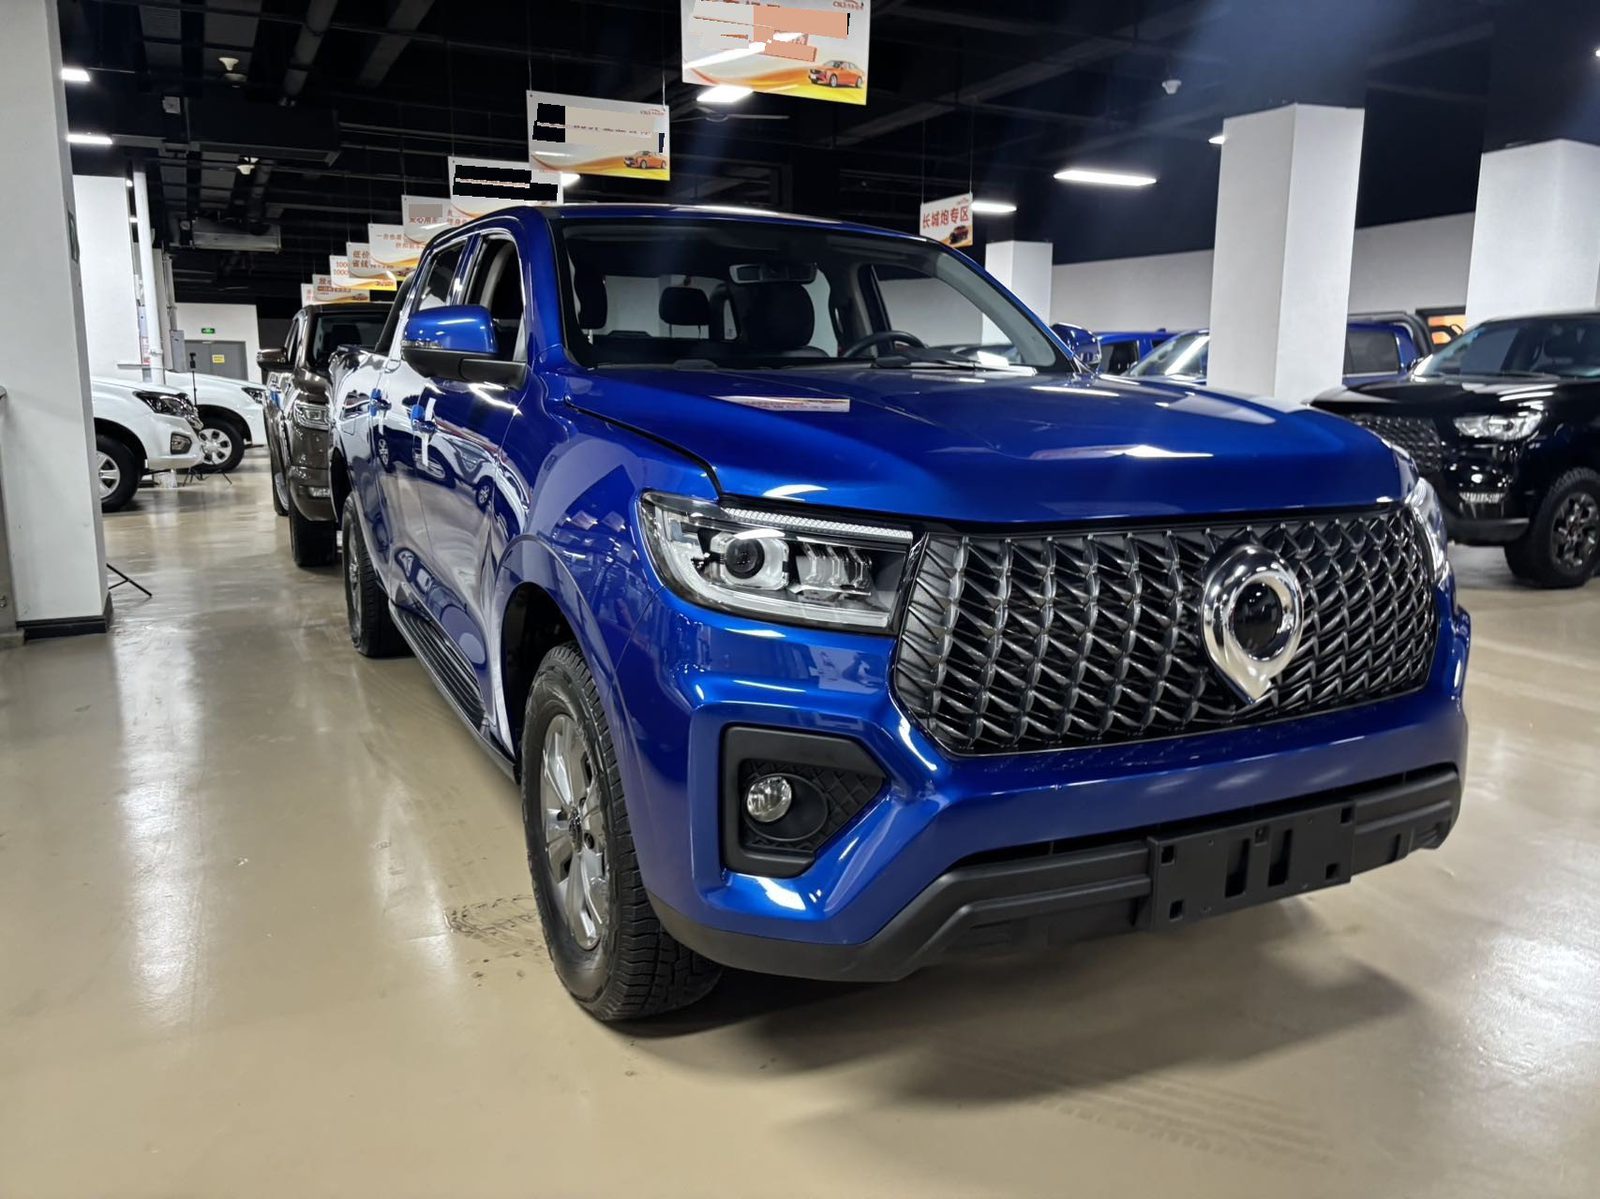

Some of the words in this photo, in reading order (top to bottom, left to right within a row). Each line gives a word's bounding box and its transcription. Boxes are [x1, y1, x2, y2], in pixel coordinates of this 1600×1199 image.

[922, 206, 969, 229] 长城炮专区
